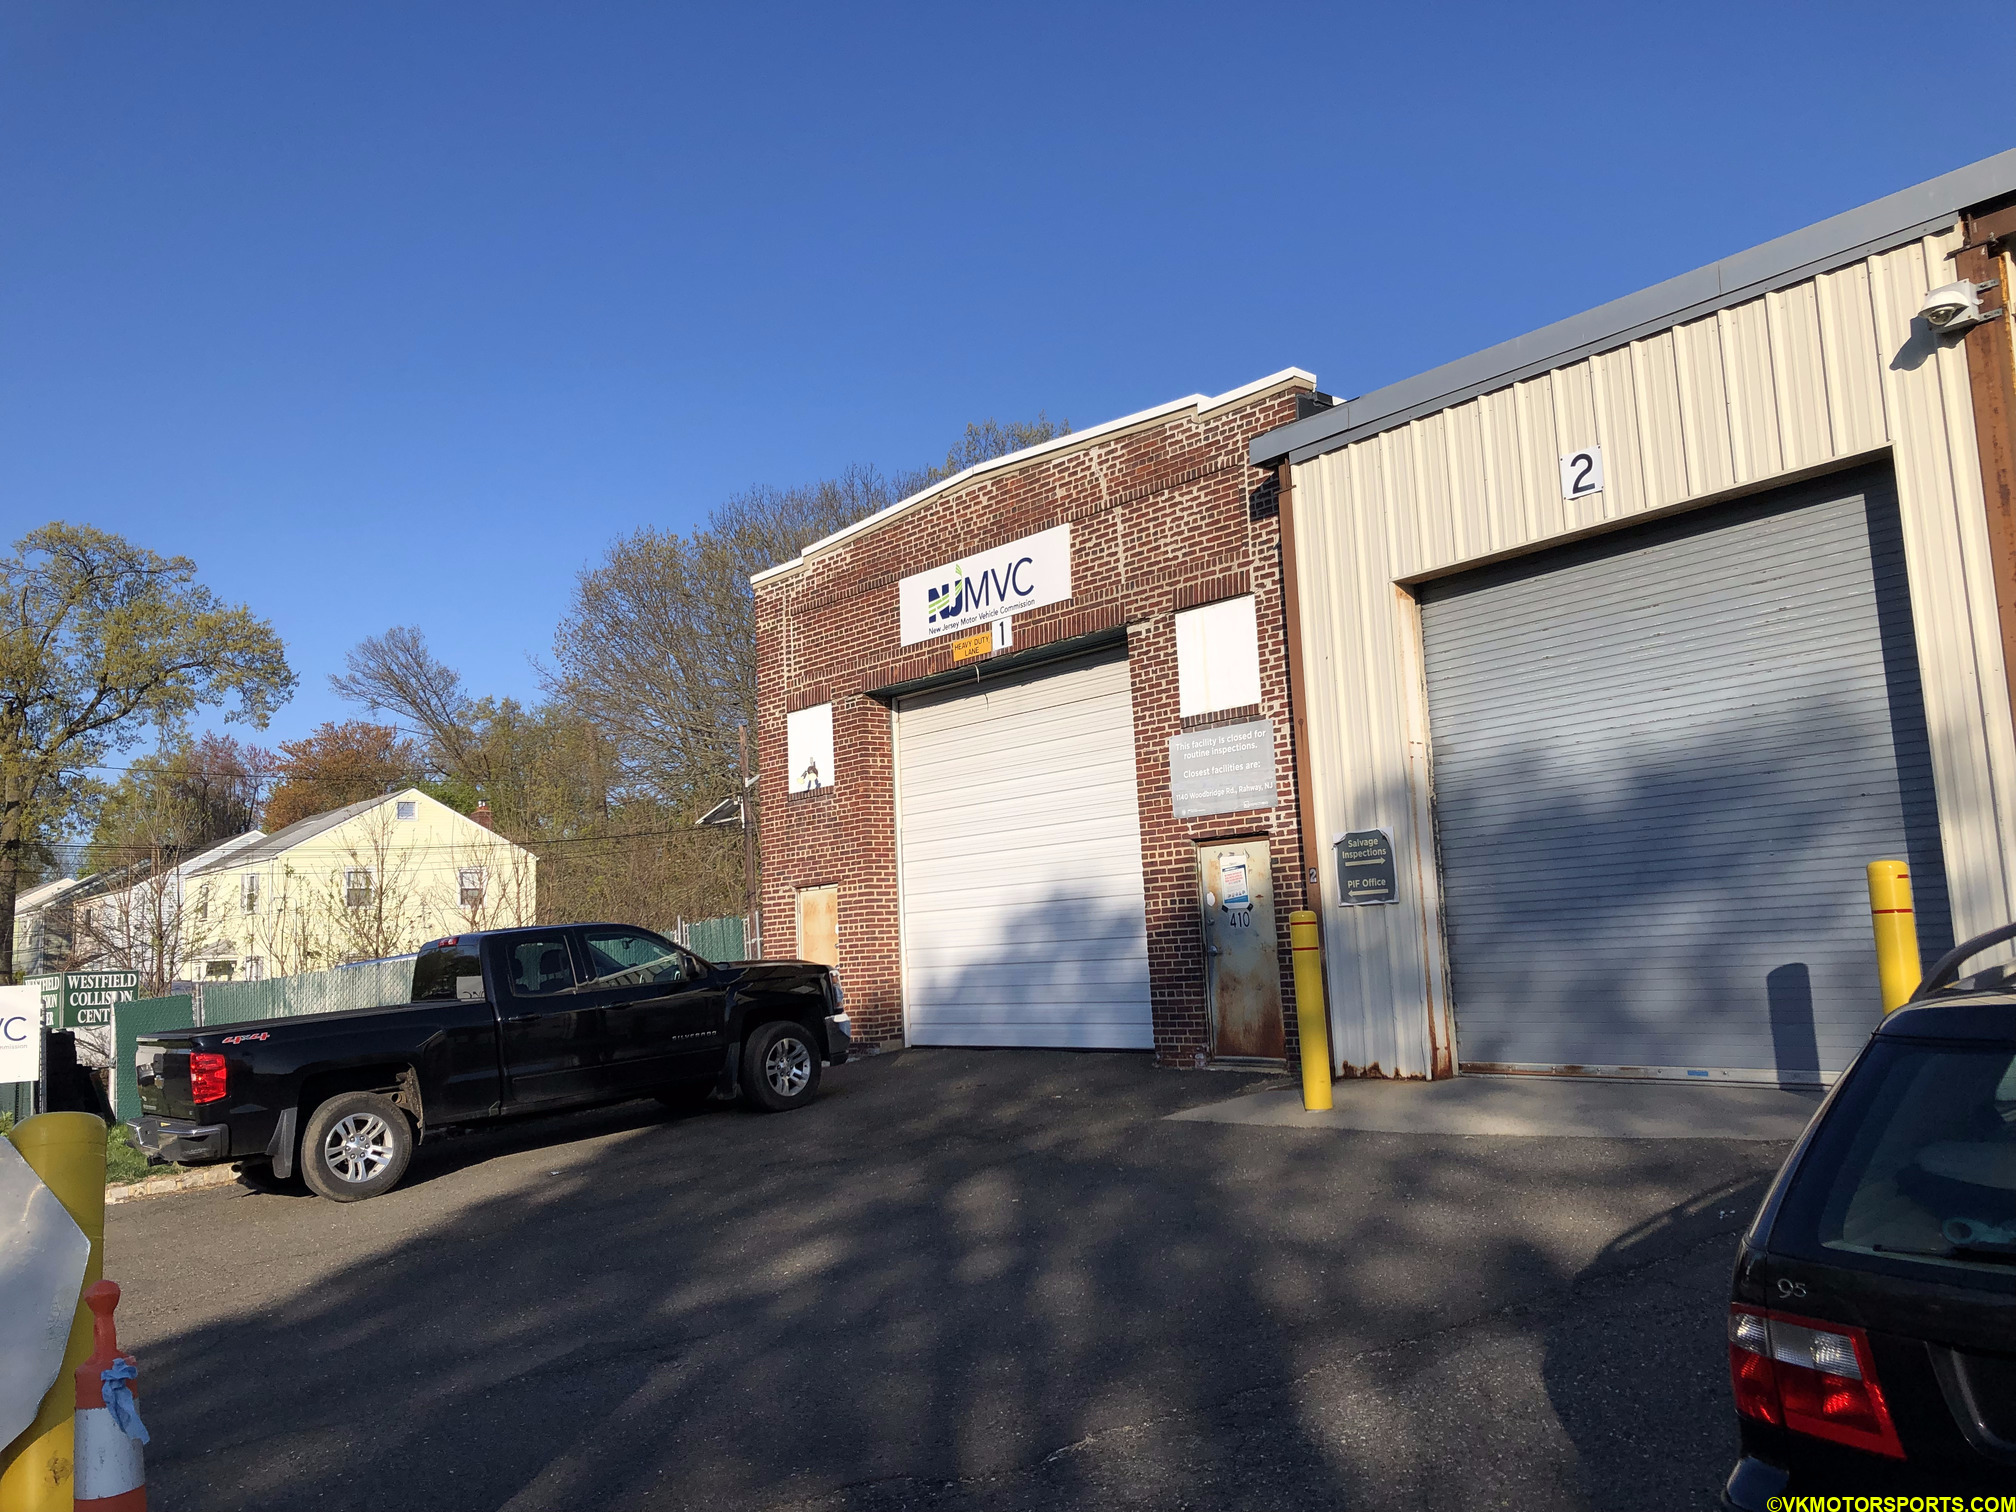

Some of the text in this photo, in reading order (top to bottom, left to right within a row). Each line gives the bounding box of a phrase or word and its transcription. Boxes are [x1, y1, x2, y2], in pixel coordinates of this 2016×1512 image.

[1570, 453, 1595, 494] 2
[928, 598, 1035, 635] New Jersey Motor Vehicle Commission
[999, 621, 1005, 646] 1
[954, 636, 989, 650] HEAVY DUTY
[964, 647, 979, 656] LANE
[1176, 730, 1266, 751] This facility is closed for
[1184, 742, 1258, 760] routine inspections.
[1184, 761, 1261, 778] Closest facilities are:
[1189, 789, 1225, 800] Woodbridge
[1239, 784, 1264, 793] Rahway,
[1347, 838, 1379, 848] Salvage
[1342, 847, 1387, 860] Inspections
[1309, 868, 1317, 883] 2
[1347, 878, 1386, 888] PIF Office
[1230, 911, 1250, 927] 410
[68, 974, 136, 989] WESTFIELD
[672, 1030, 717, 1040] SILVERADO
